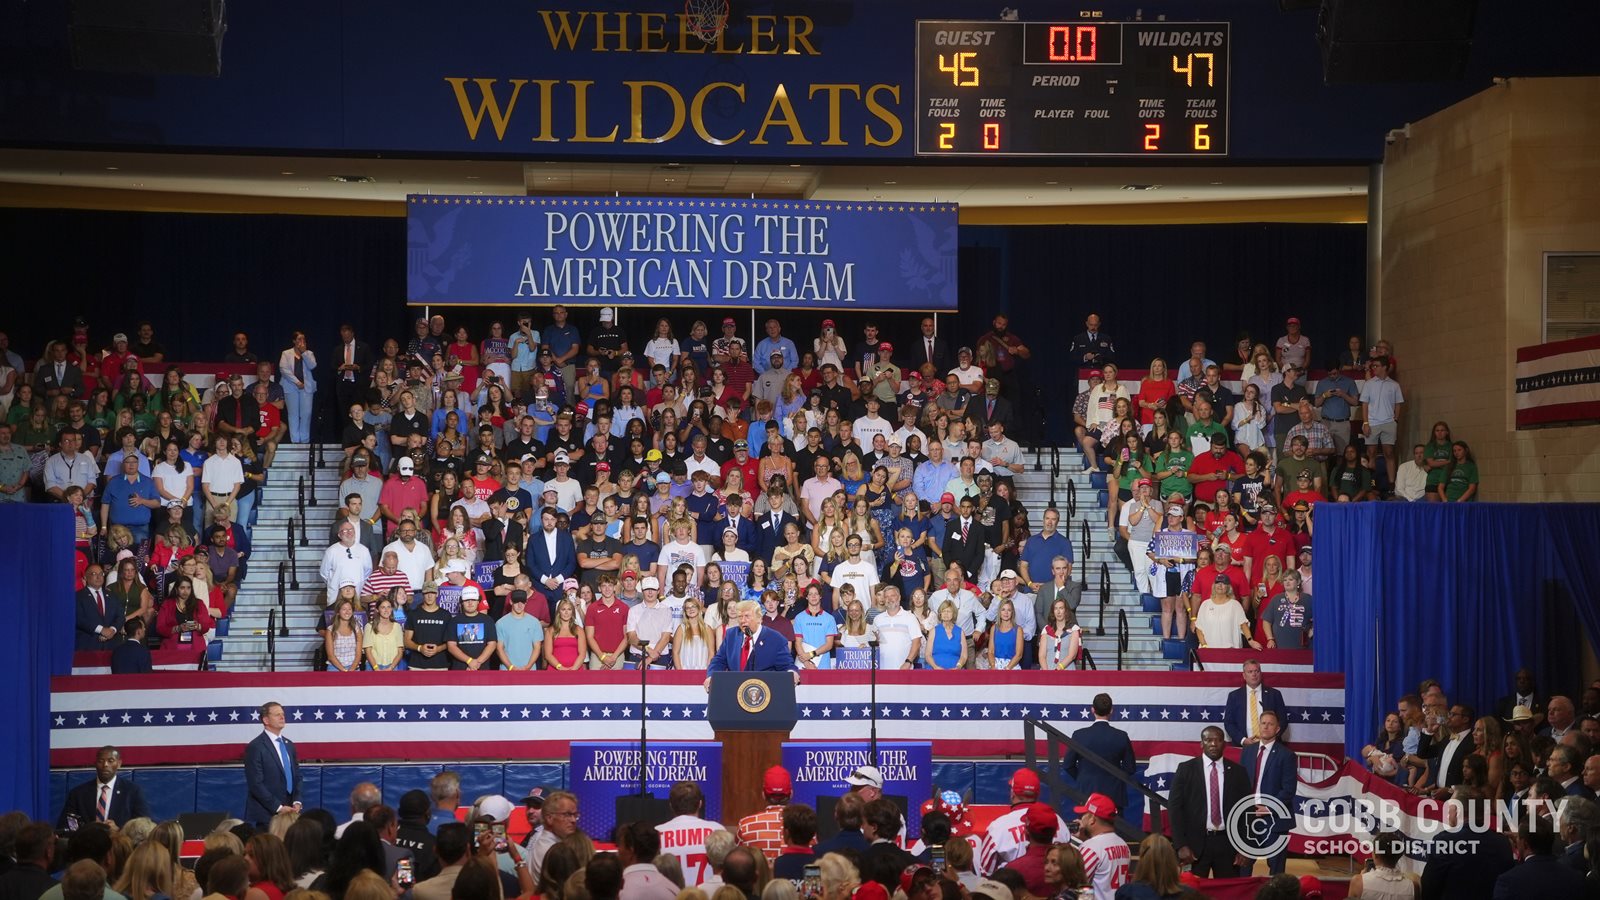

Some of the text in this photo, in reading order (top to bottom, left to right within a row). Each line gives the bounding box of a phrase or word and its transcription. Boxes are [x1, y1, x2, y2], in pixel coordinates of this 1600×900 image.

[537, 10, 821, 55] WHEELER
[934, 30, 995, 46] GUEST
[1137, 31, 1224, 46] WILDCATS
[1049, 26, 1096, 61] 0.0
[938, 52, 980, 87] 45
[1173, 52, 1214, 87] 47
[1032, 75, 1080, 87] PERIOD
[929, 98, 959, 107] TEAM
[979, 98, 1006, 107] TIME
[1139, 99, 1165, 108] TIME
[1186, 99, 1216, 108] TEAM
[444, 76, 903, 147] WILDCATS
[928, 108, 960, 118] FOULS
[979, 108, 1006, 118] OUTS
[1034, 109, 1110, 119] PLAYER FOUL
[1138, 109, 1165, 119] OUTS
[1185, 109, 1218, 119] FOULS
[939, 123, 955, 149] 2
[983, 123, 999, 150] 0
[1144, 124, 1160, 150] 2
[1194, 124, 1210, 150] 6
[544, 211, 829, 256] POWERING THE
[514, 257, 856, 302] AMERICAN DREAM
[1160, 540, 1193, 548] AMERICAN
[1160, 547, 1193, 557] DREAM
[721, 564, 747, 574] TRUMP
[721, 573, 749, 583] COUNT
[440, 595, 461, 603] AMERI
[844, 650, 872, 660] TRUMP
[594, 750, 698, 767] POWERNG THE
[880, 750, 908, 766] THE
[658, 766, 707, 781] DREAM
[796, 766, 917, 782] AMERIC REAM
[396, 838, 424, 850] TIVE
